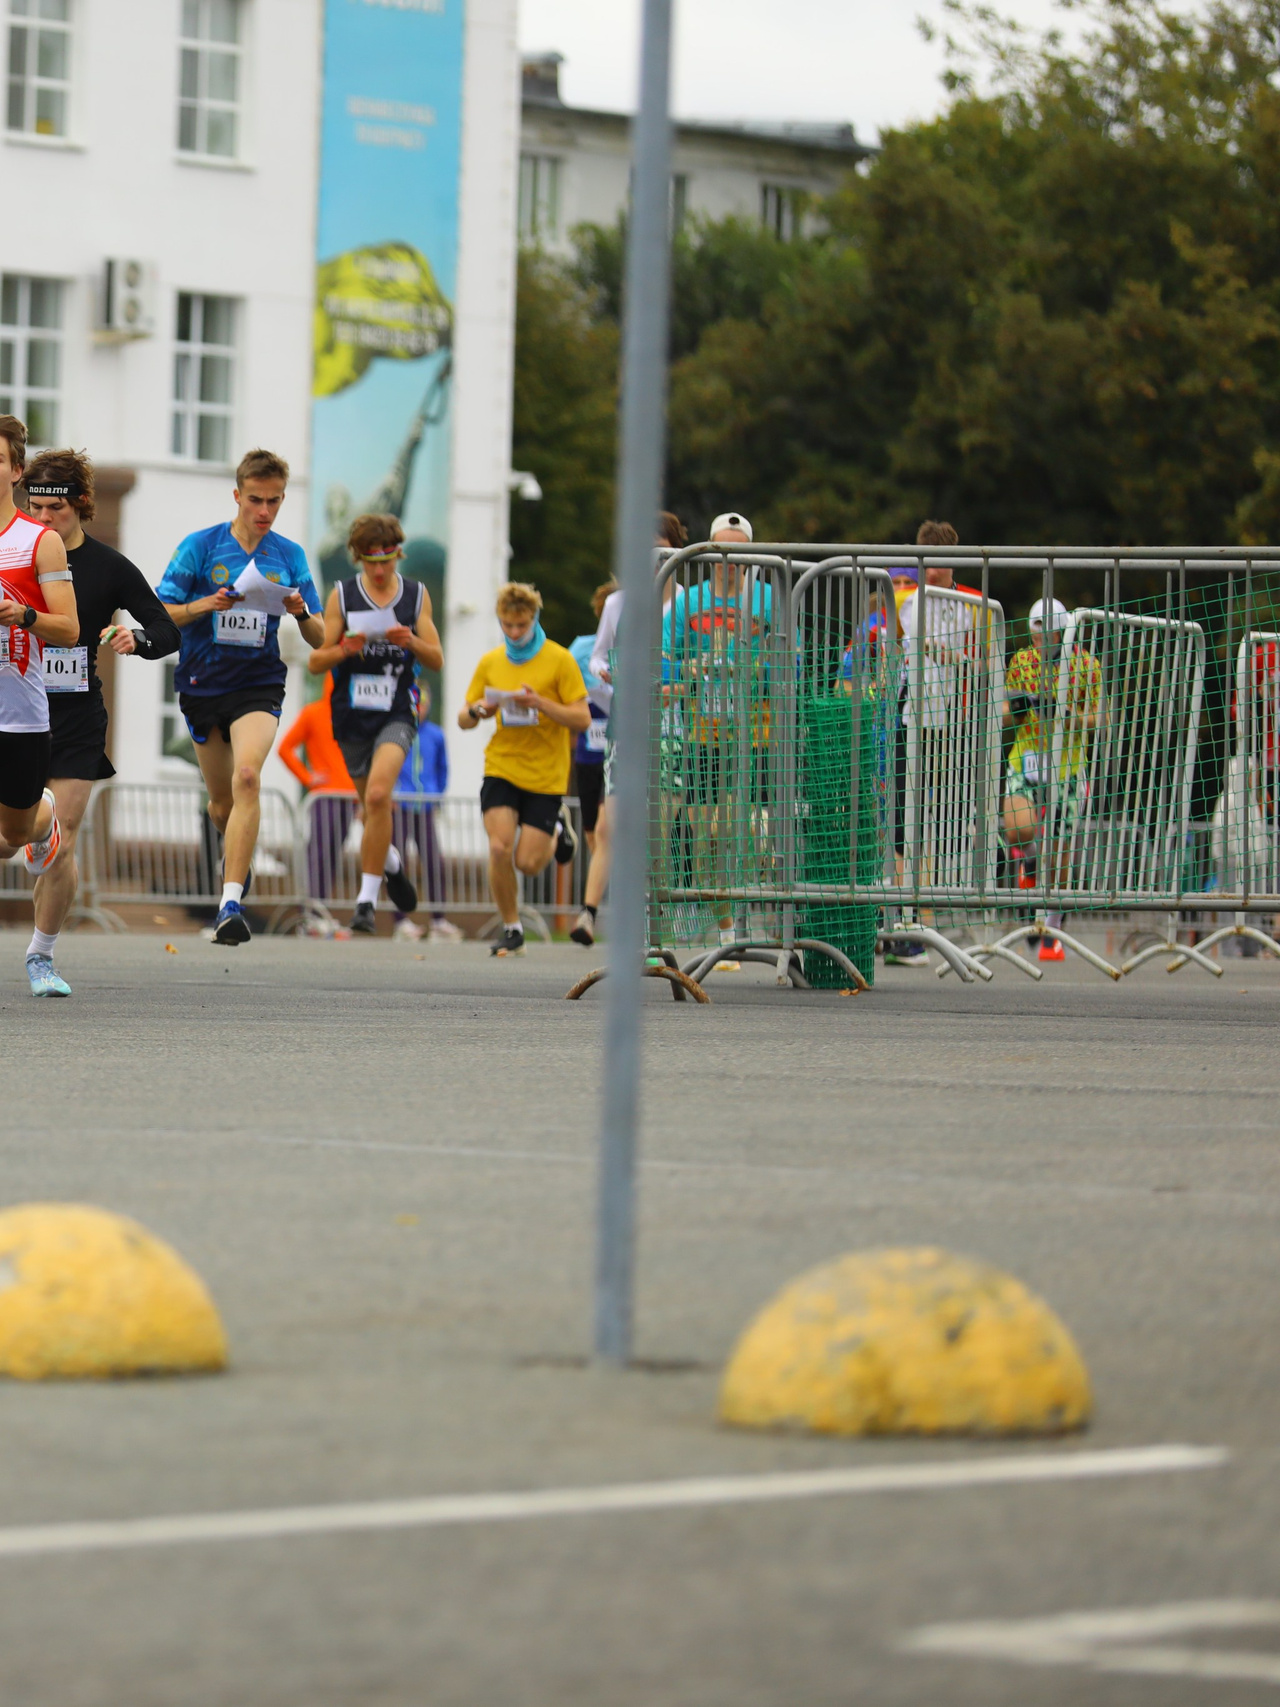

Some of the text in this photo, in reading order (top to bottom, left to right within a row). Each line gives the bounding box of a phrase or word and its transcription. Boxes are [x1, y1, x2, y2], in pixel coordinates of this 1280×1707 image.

[29, 486, 69, 494] noname
[221, 615, 258, 630] 102.1
[12, 627, 26, 661] think
[45, 659, 78, 675] 10.1
